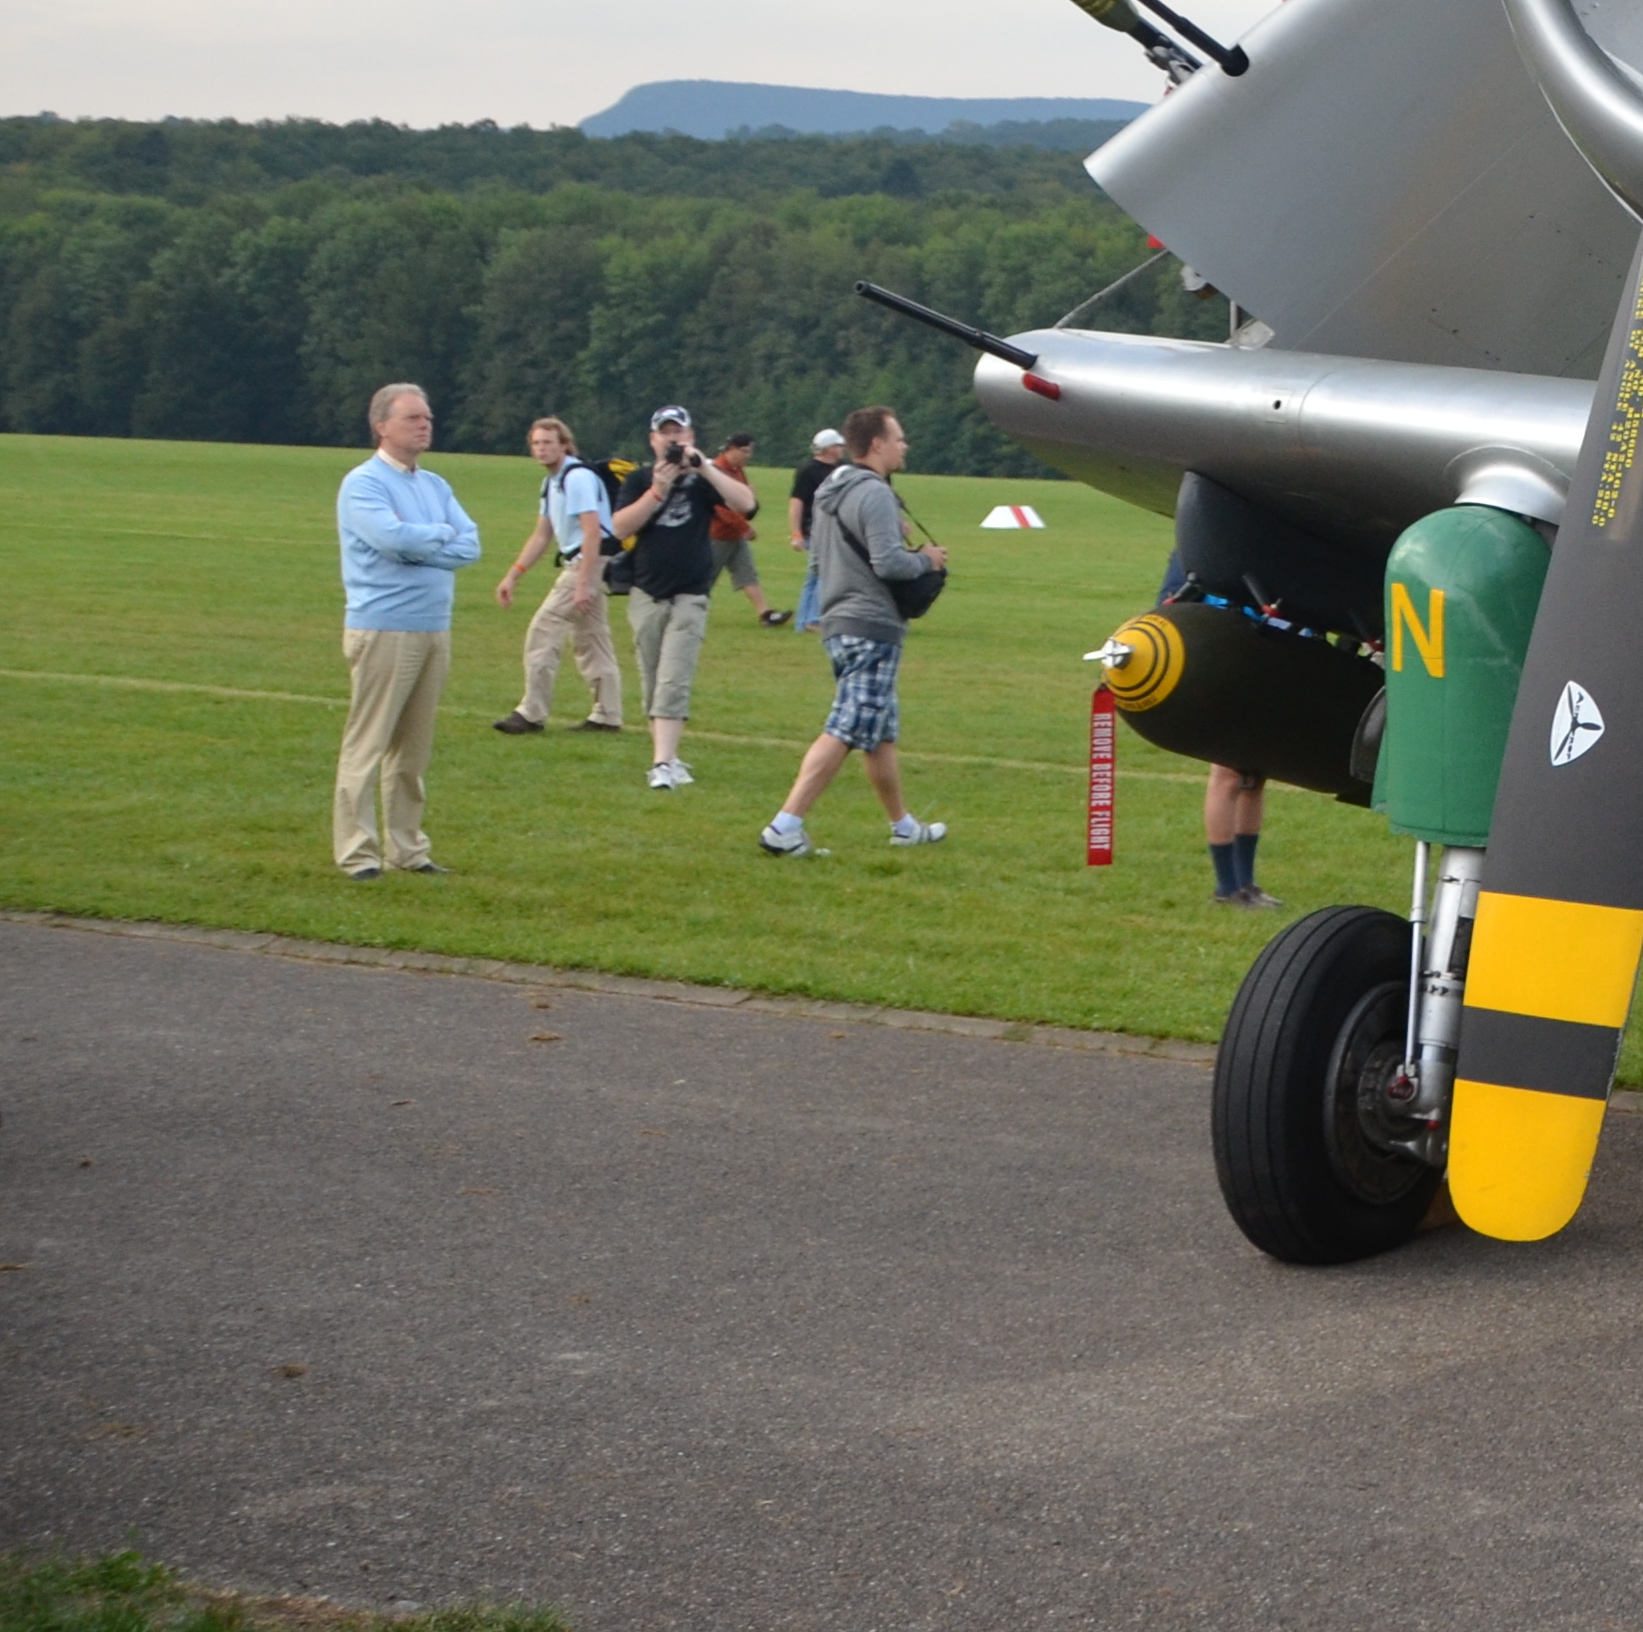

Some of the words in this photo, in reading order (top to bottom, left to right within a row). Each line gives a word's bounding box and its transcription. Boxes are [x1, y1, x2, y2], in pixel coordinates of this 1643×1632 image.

[1391, 582, 1445, 679] N
[1091, 712, 1114, 760] REMOVE
[1089, 762, 1114, 808] BEFORE
[1088, 810, 1113, 851] FLIGHT
